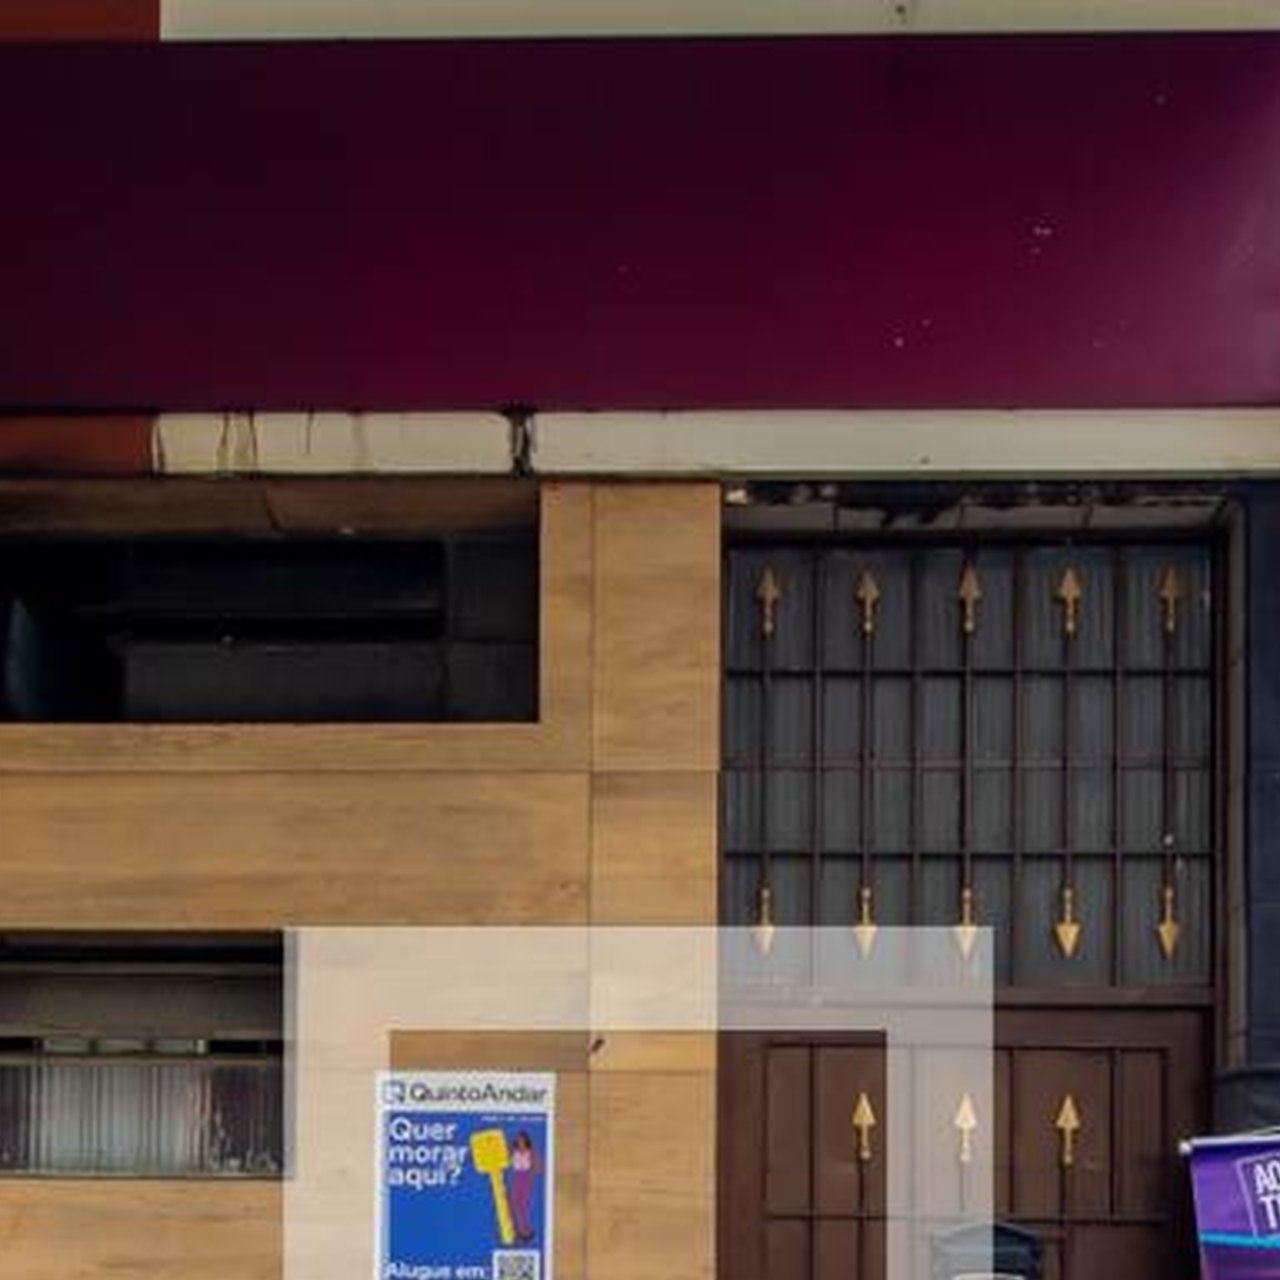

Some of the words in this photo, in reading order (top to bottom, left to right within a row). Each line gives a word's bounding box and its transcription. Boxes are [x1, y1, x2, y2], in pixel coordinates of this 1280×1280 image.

[409, 1082, 548, 1101] QuintoAndar
[391, 1117, 457, 1142] Quer
[390, 1145, 468, 1163] morar
[390, 1160, 462, 1190] aqui?
